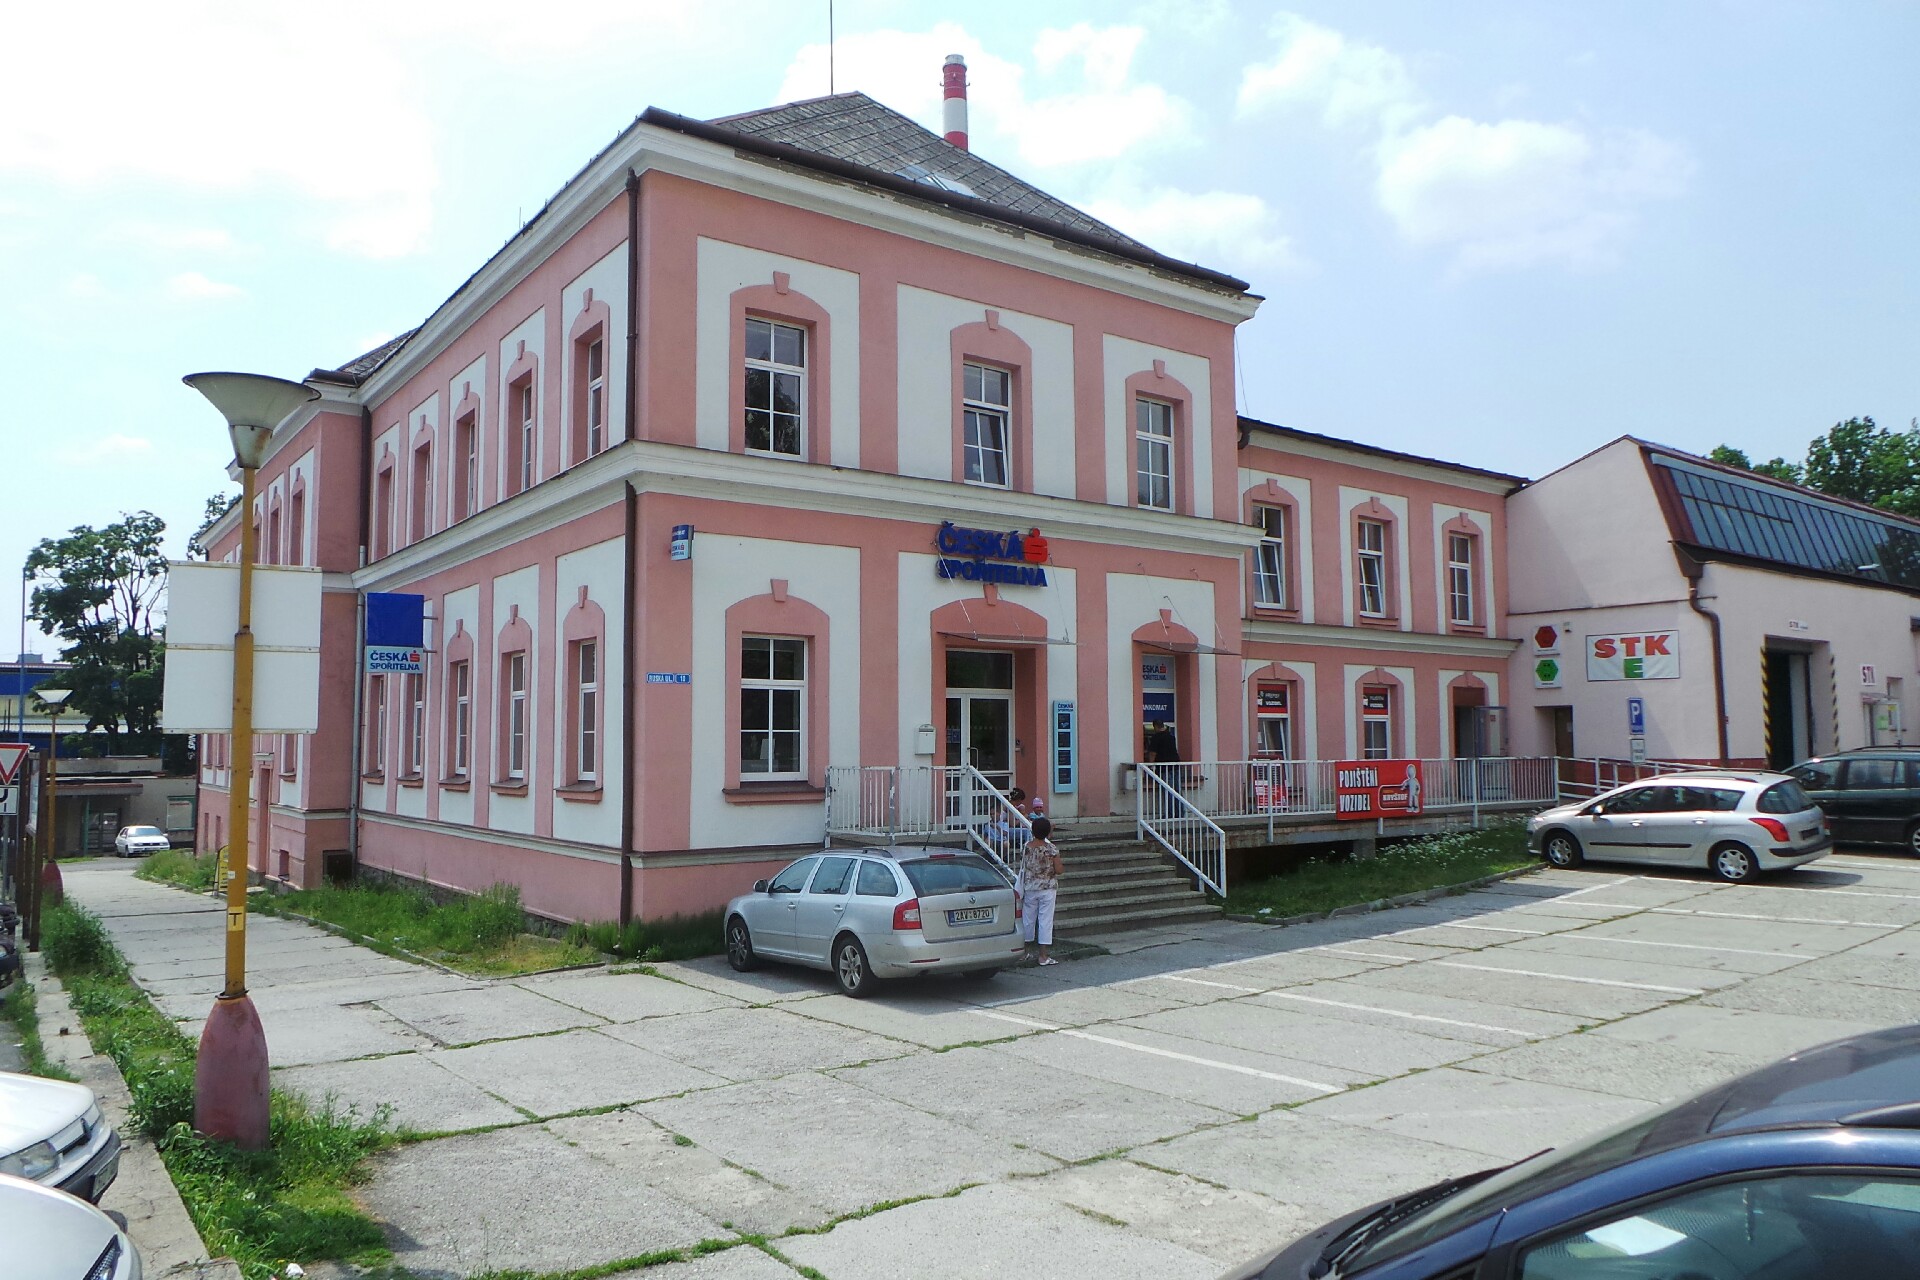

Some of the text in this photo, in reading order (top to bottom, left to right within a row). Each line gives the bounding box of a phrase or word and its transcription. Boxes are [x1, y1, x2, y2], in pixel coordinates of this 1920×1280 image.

[938, 520, 1025, 561] ČESKÁ
[936, 557, 1048, 588] SPOŘITELNA
[370, 650, 408, 662] ČESKÁ
[1594, 634, 1671, 659] STK
[370, 662, 420, 671] SPOŘITELNA
[1142, 664, 1159, 674] ESKÁ
[1142, 673, 1167, 681] OŘITELNA
[1623, 658, 1644, 679] E
[1631, 702, 1641, 724] P
[1339, 767, 1378, 788] POJIŠTĚNÍ
[1340, 794, 1371, 812] VOZIDEL
